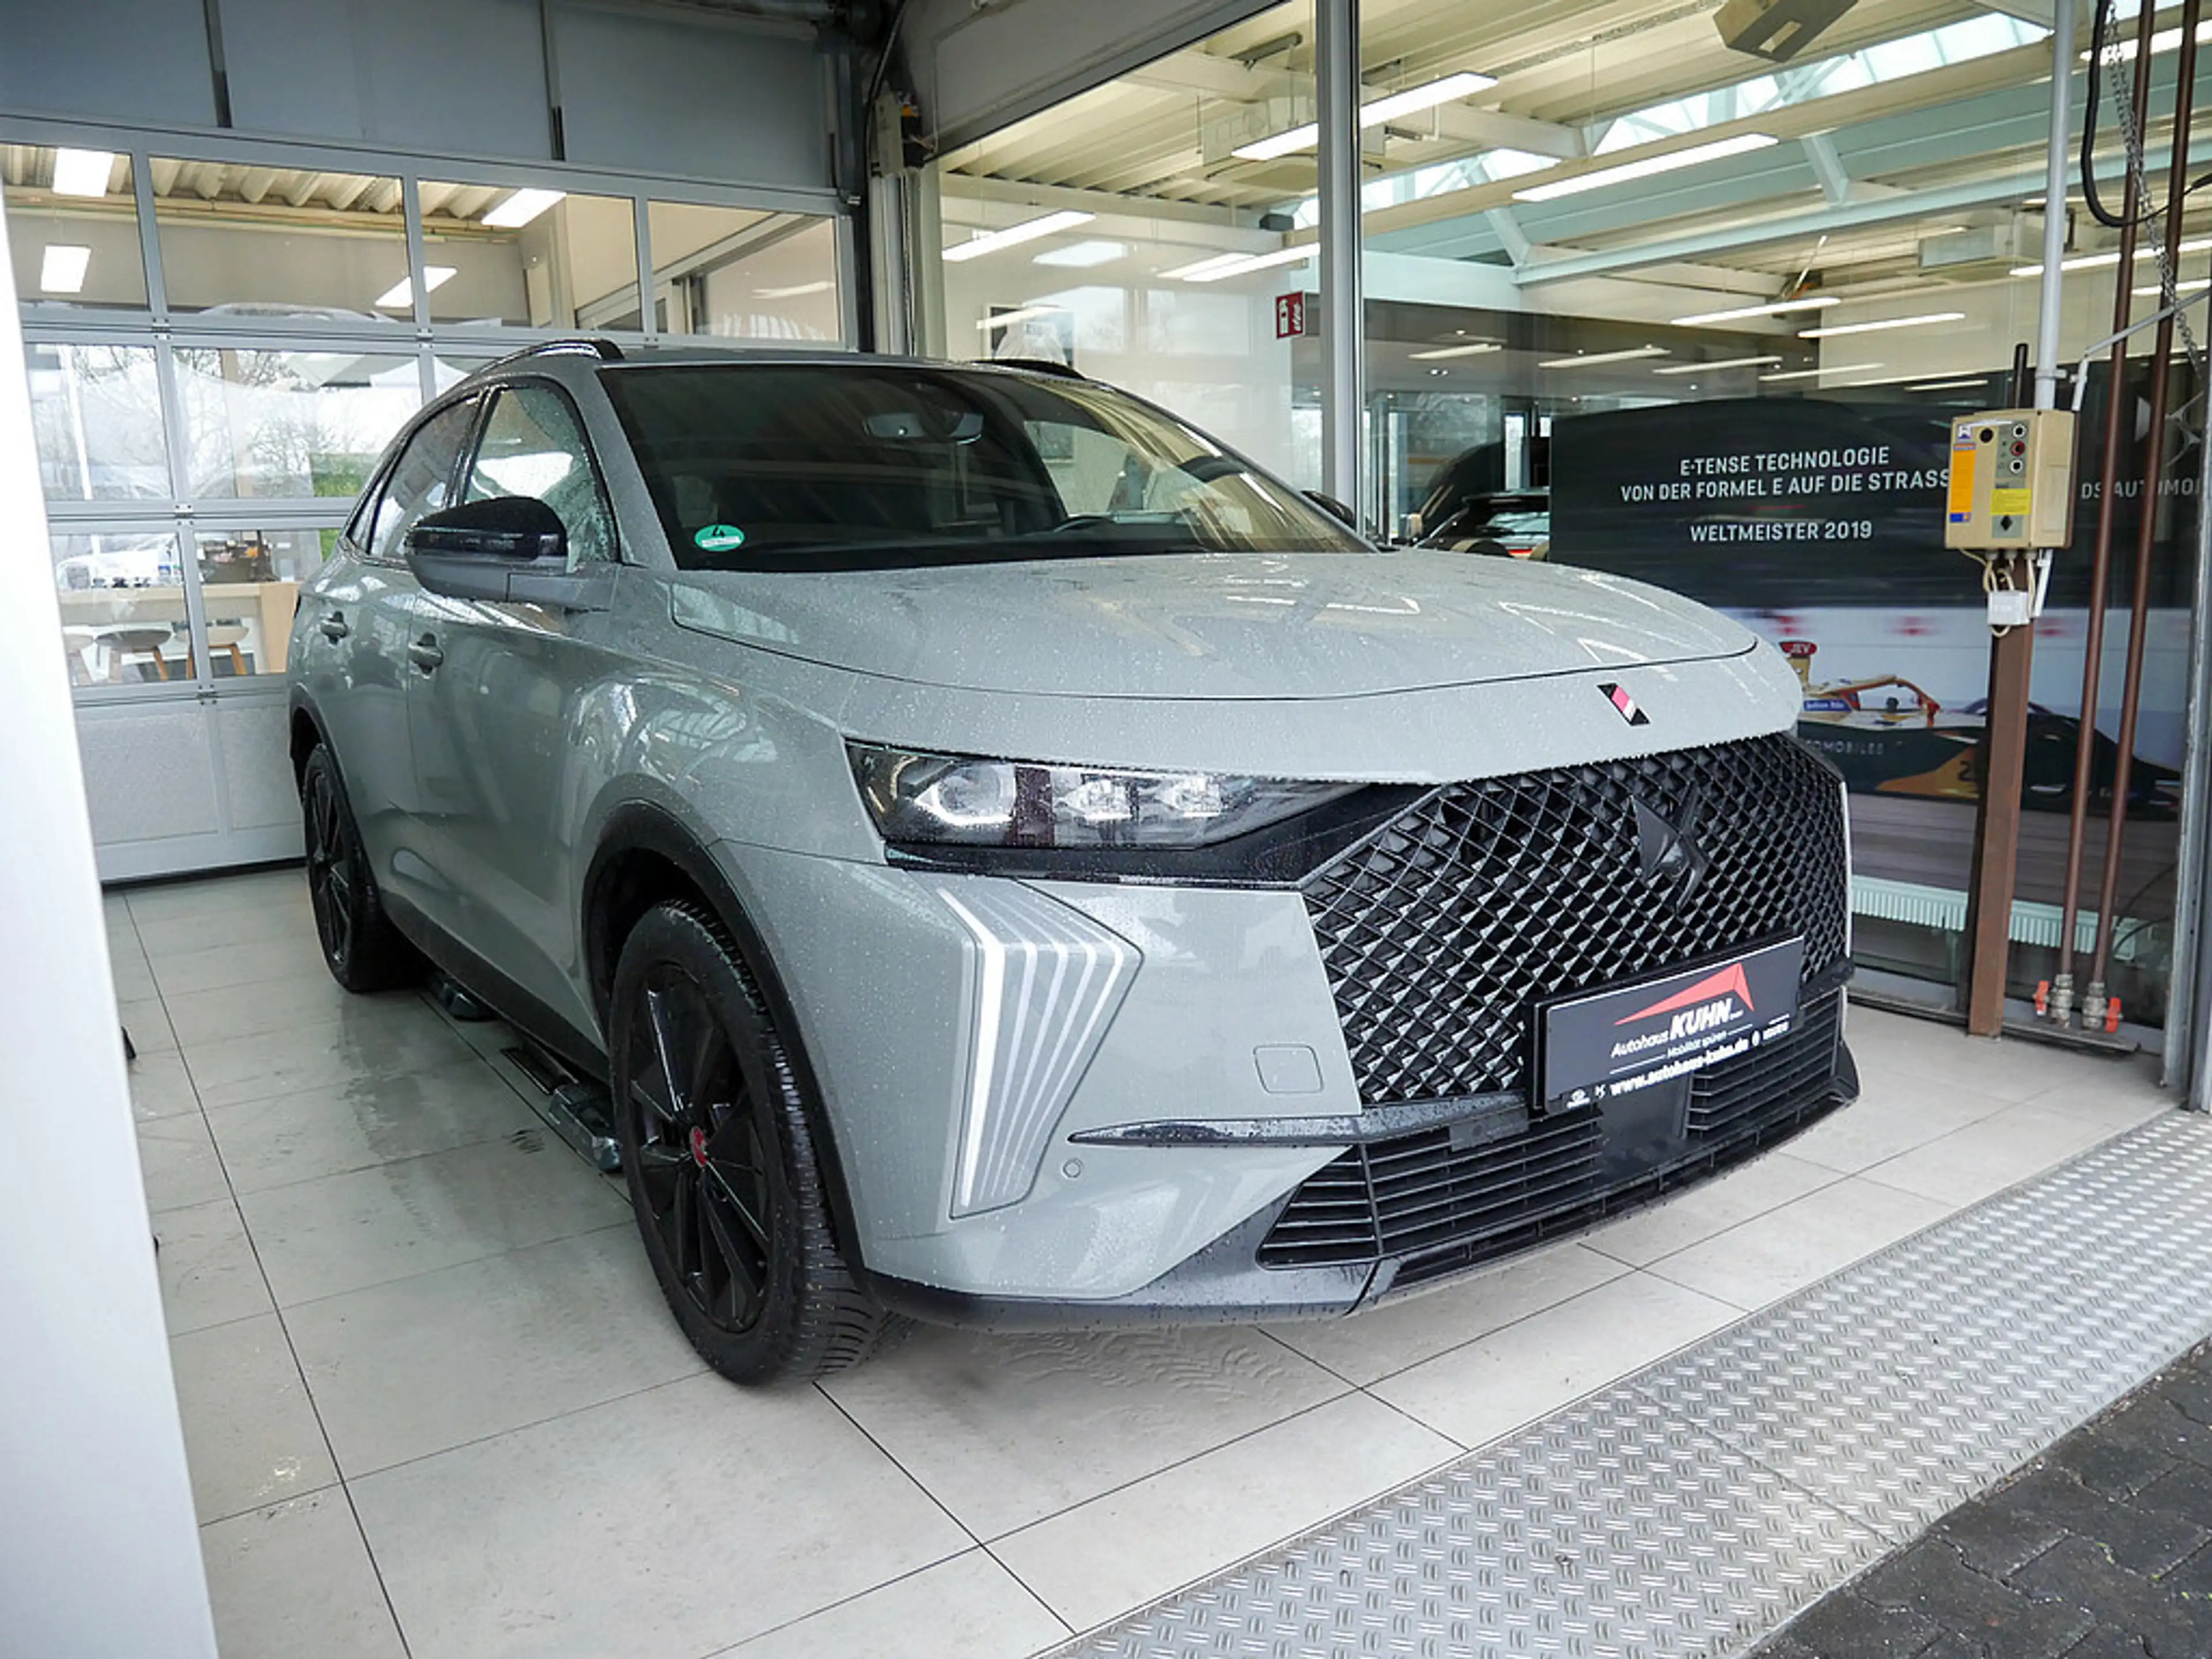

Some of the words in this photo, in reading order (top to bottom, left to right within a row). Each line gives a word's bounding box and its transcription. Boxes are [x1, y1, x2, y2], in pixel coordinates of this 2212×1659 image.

[1755, 446, 1889, 472] TECHNOLOGIE
[1620, 484, 1654, 502] VON
[1659, 482, 1690, 500] DER
[1696, 479, 1767, 498] FORMEL
[1772, 477, 1783, 495] E
[1788, 475, 1826, 494] AUF
[1831, 473, 1863, 492] DIE
[1690, 521, 1819, 541] WELTMEISTER
[1825, 520, 1872, 539] 2019
[1610, 1029, 1670, 1059] Autohaus
[1669, 998, 1734, 1040] KUHN
